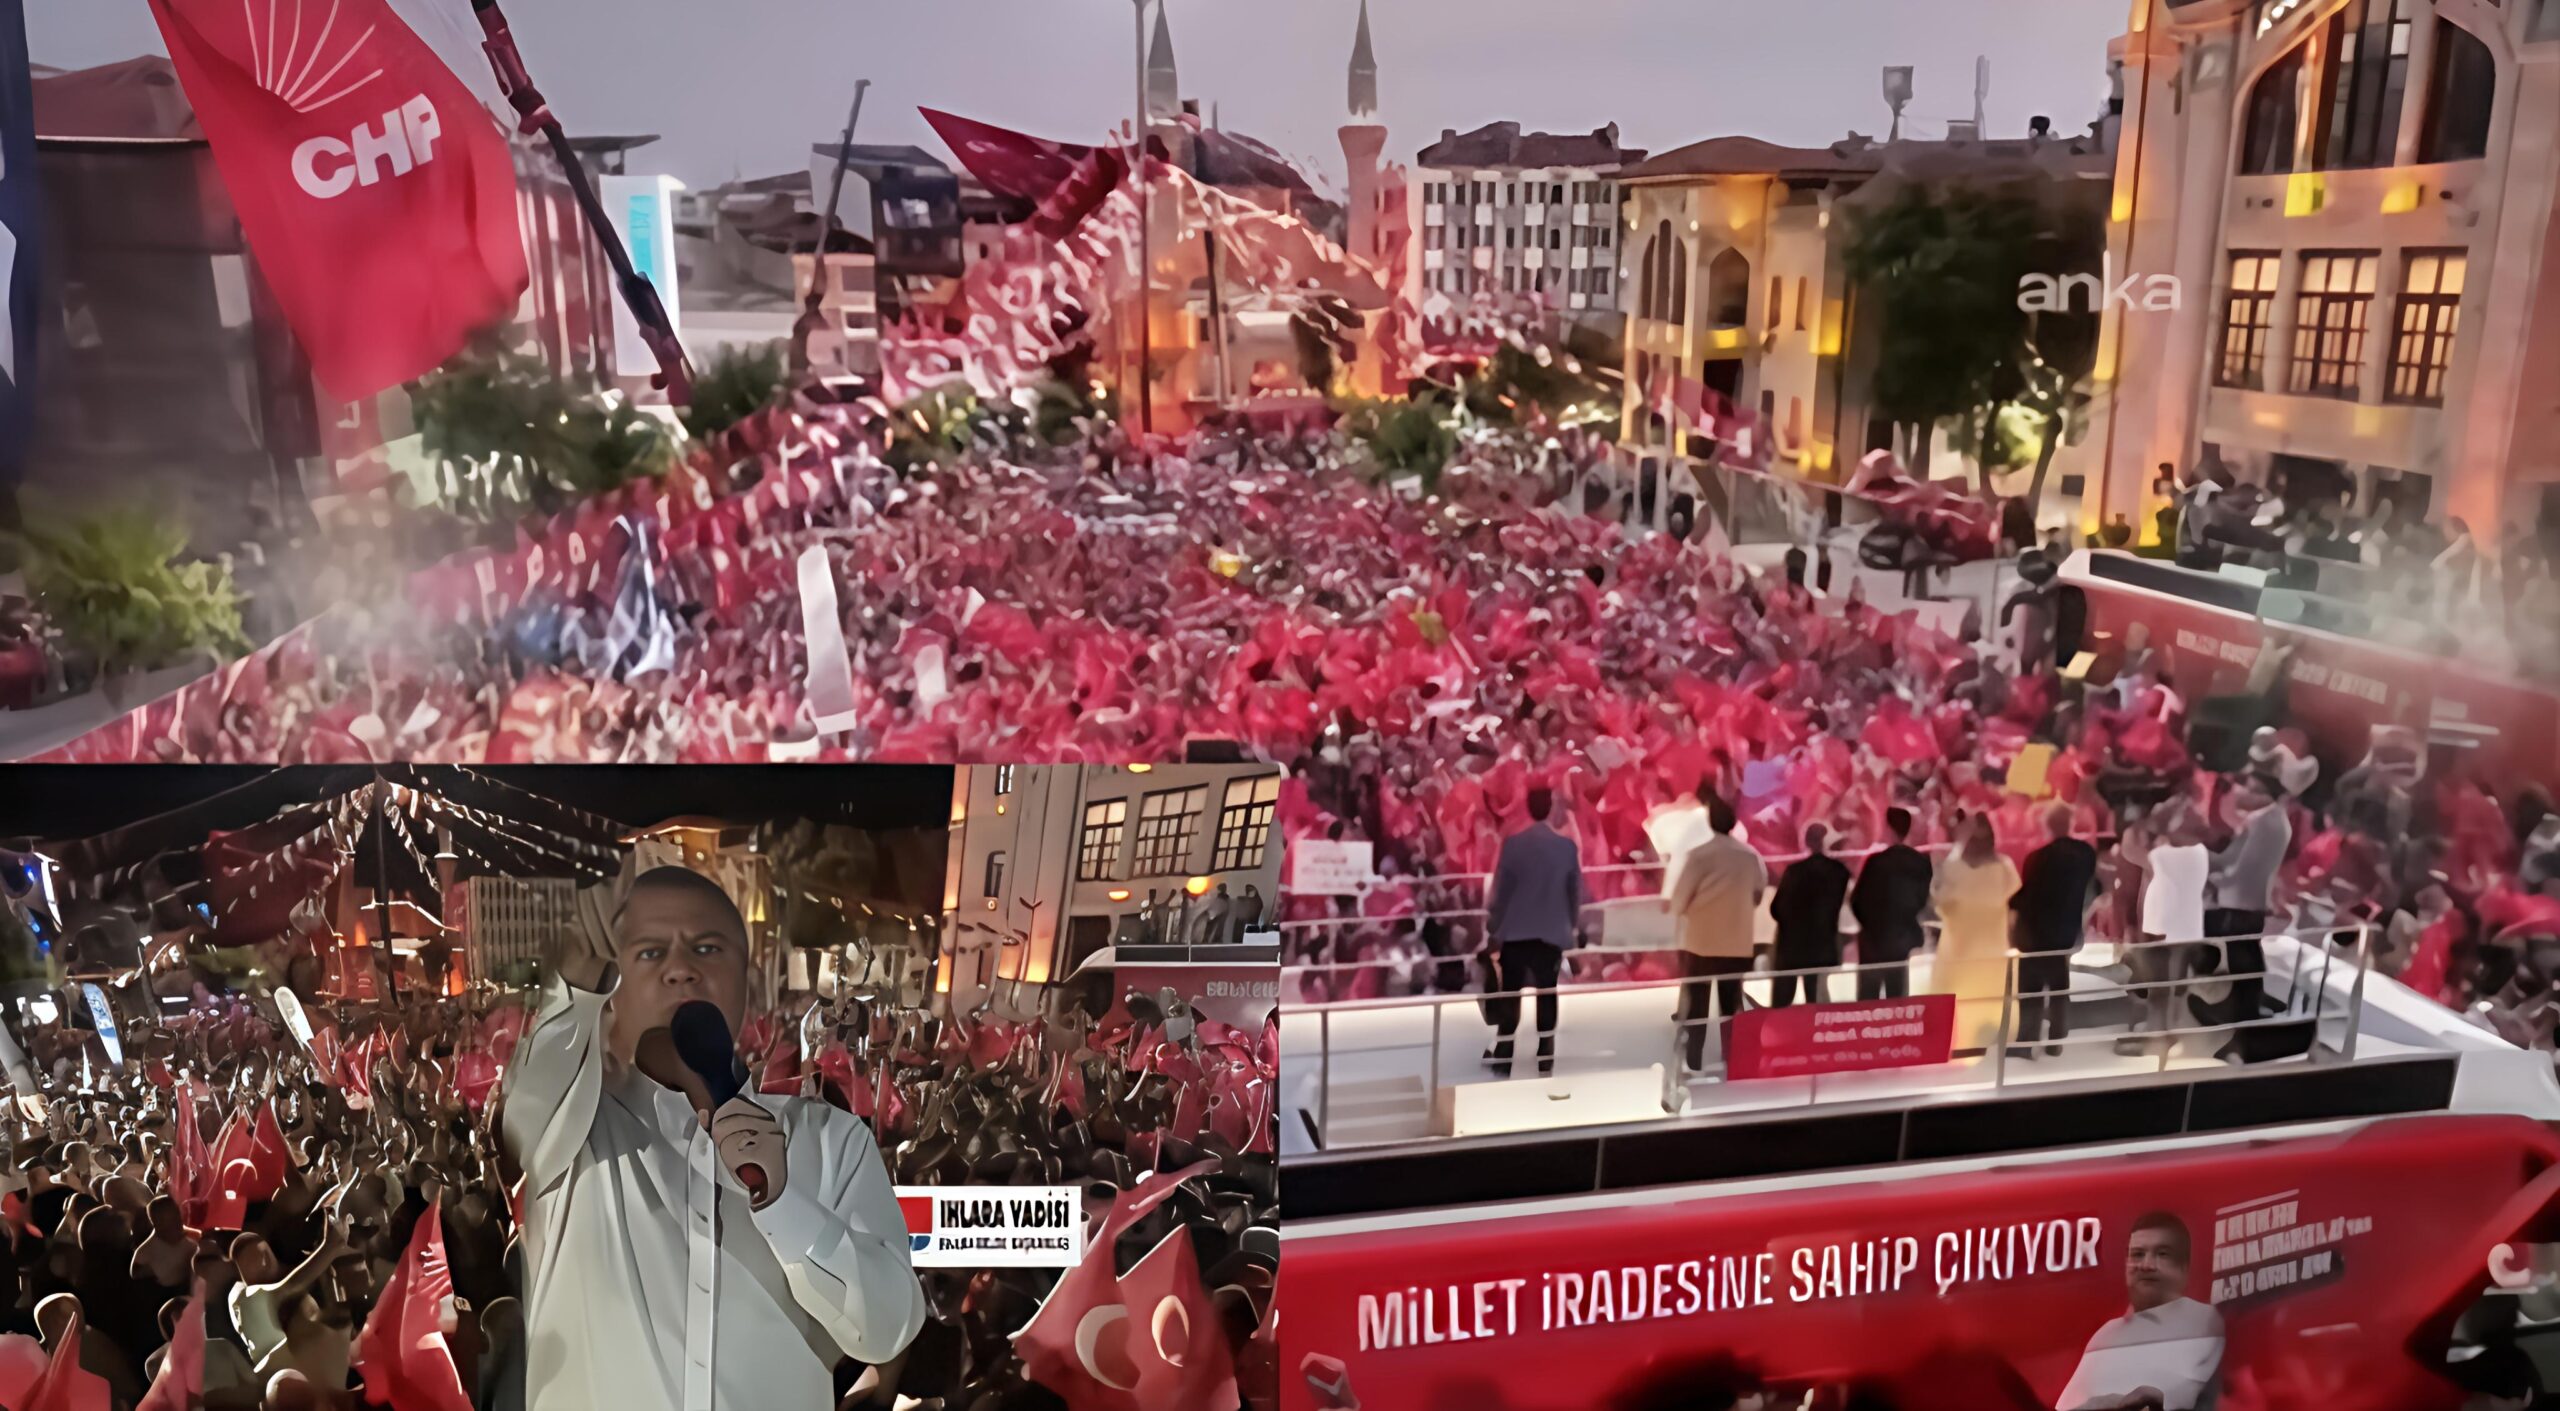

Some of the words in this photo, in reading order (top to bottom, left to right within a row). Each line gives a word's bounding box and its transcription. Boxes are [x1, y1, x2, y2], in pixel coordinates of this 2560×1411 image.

[291, 93, 441, 199] CHP
[1358, 1279, 1527, 1352] MİLLET
[1541, 1252, 1776, 1331] İRADESİNE
[1789, 1236, 1919, 1303] SAHİP
[1934, 1217, 2102, 1298] ÇIKIYOR
